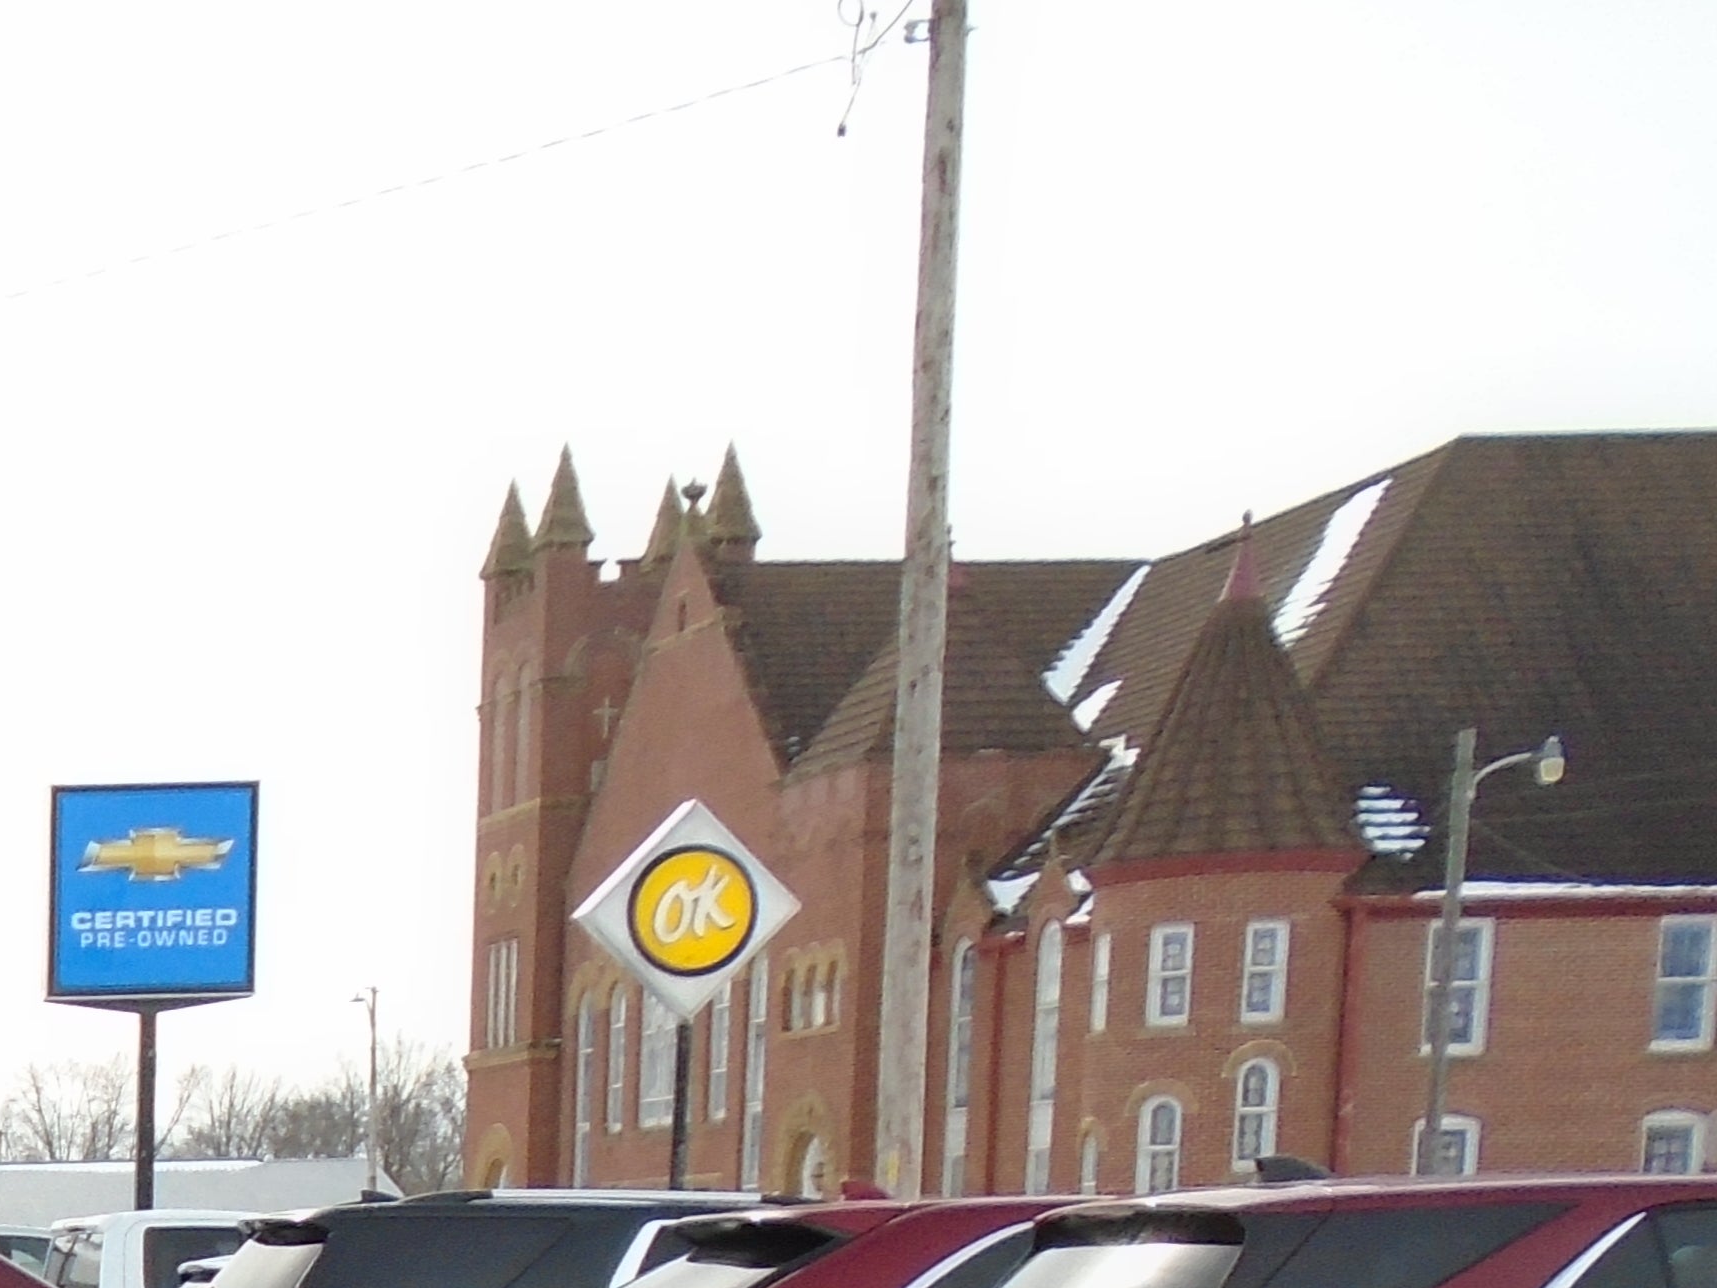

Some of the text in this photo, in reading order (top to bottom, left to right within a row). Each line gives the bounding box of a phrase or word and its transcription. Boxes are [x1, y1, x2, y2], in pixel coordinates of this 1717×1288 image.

[653, 864, 737, 944] OK
[70, 908, 239, 930] CERTIFIED
[80, 929, 229, 948] PRE-OWNED
